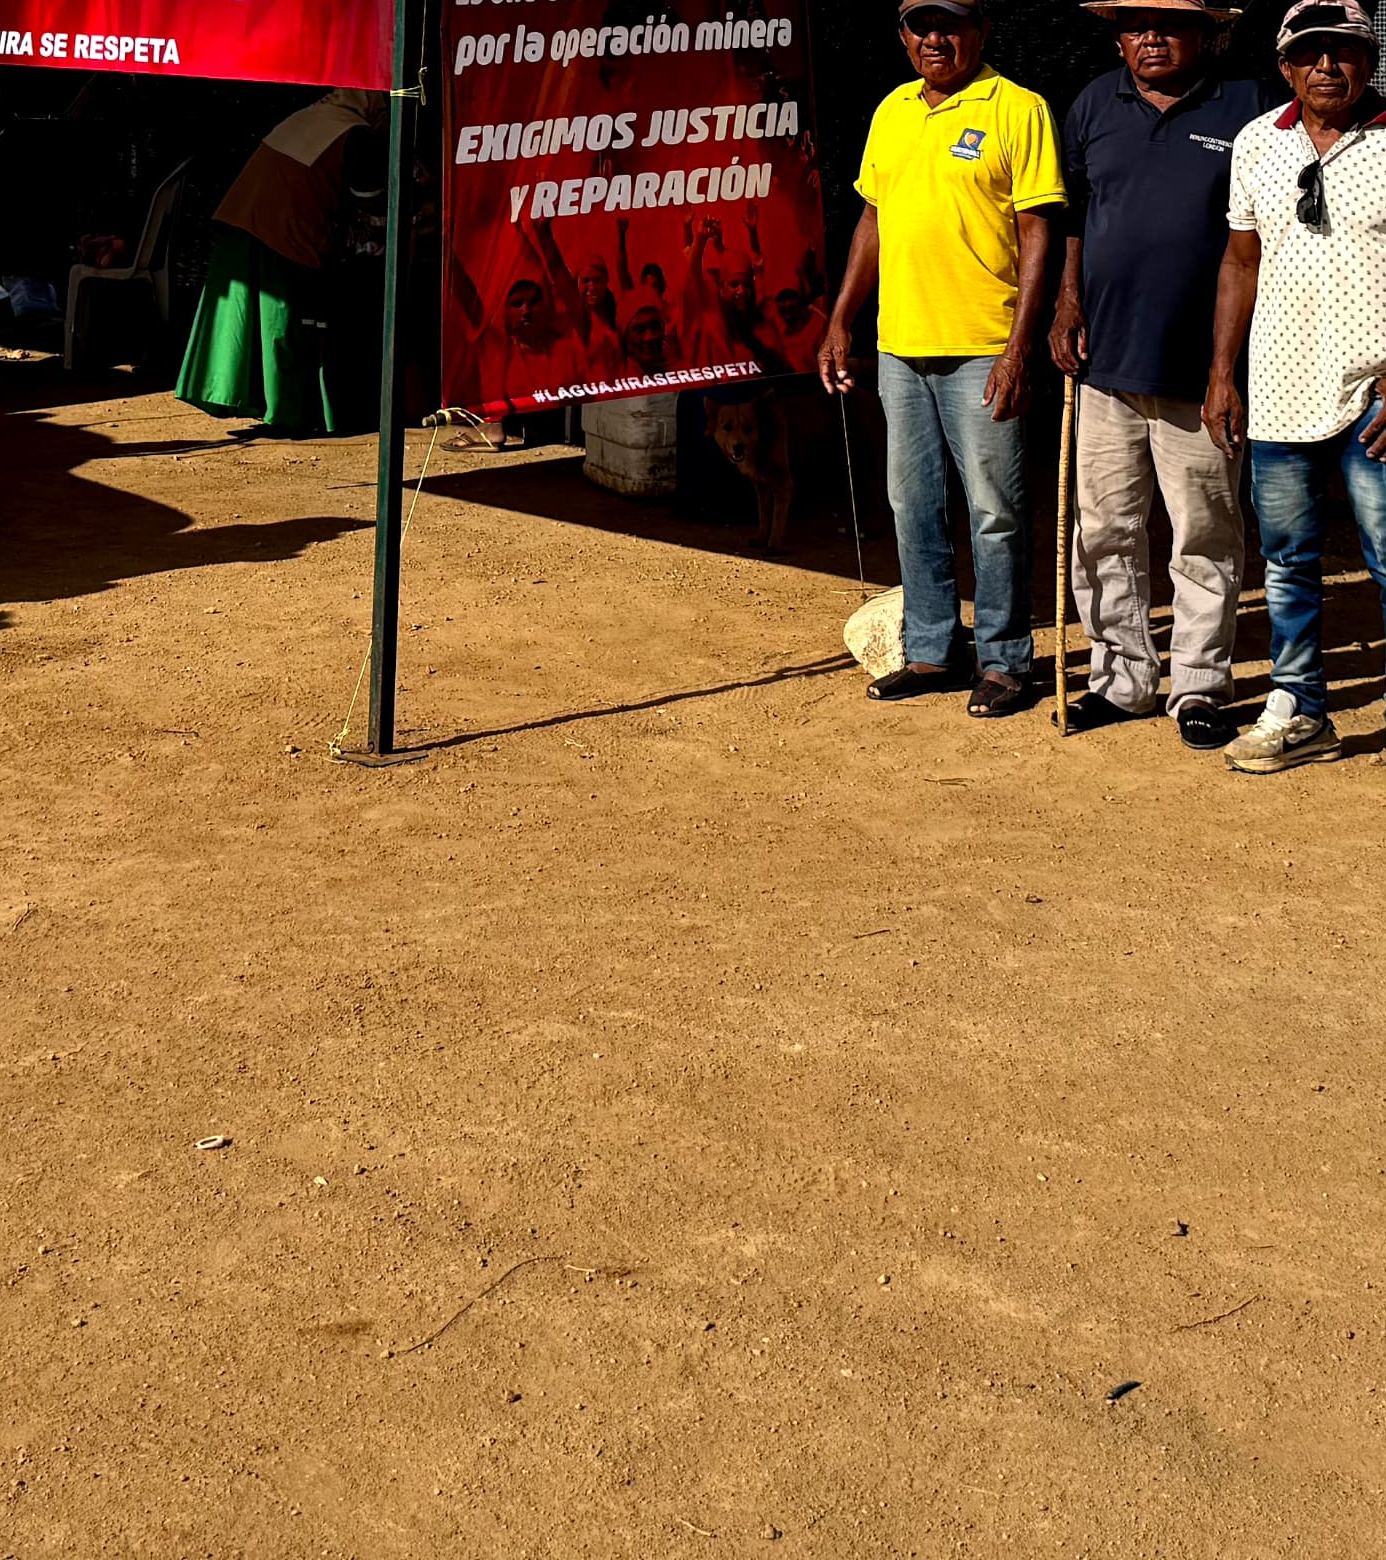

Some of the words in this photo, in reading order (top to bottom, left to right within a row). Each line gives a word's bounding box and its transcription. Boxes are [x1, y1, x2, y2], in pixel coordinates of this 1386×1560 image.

[40, 32, 69, 58] SE
[74, 34, 180, 65] RESPETA
[454, 33, 511, 76] por
[513, 24, 545, 64] la
[550, 14, 690, 68] operación
[694, 11, 793, 51] minera
[455, 112, 638, 165] EXIGIMOS
[641, 101, 799, 148] JUSTICIA
[509, 185, 530, 224] Y
[530, 156, 772, 220] REPARACIÓN
[532, 360, 762, 403] #LAGUAJIRASERESPETA
